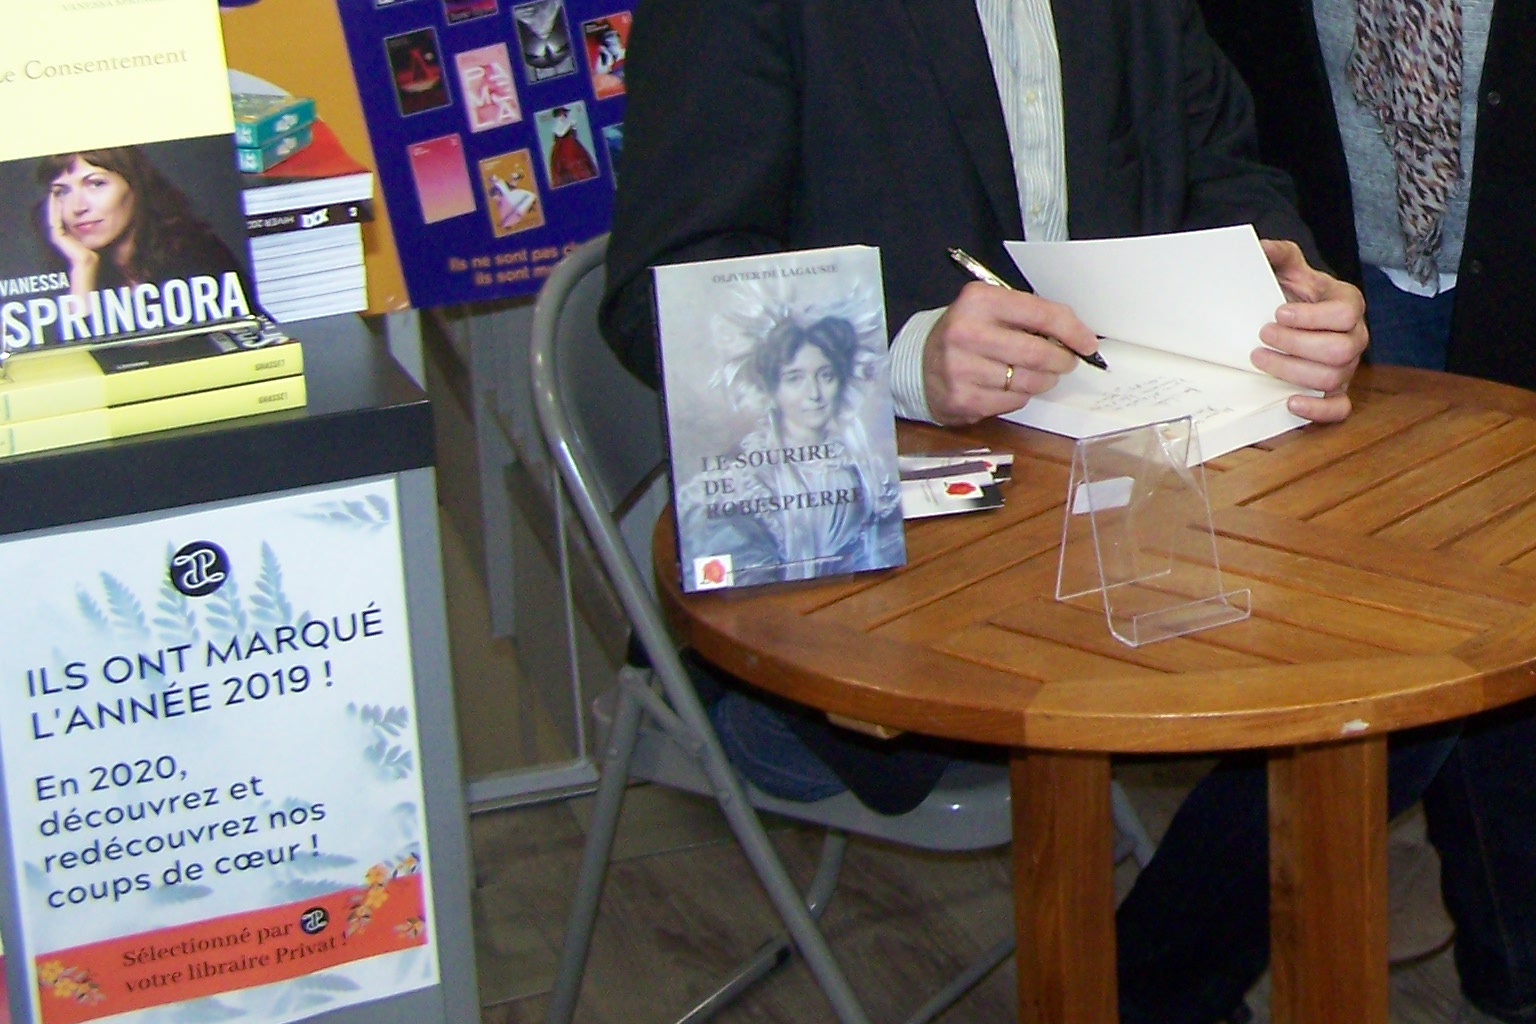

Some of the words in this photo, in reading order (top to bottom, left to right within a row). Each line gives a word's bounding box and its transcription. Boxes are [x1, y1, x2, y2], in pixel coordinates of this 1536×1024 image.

[24, 48, 188, 80] Consentement
[0, 271, 70, 297] VANESSA
[780, 263, 839, 278] LAGAUSIE
[0, 271, 250, 349] SPRINGORA
[702, 455, 729, 472] LE
[735, 442, 838, 469] SOURIRE
[704, 477, 735, 496] DE
[706, 486, 863, 519] ROBESPIERRE
[27, 661, 88, 697] ILS
[103, 642, 192, 684] ONT
[206, 602, 384, 668] MARQUÉ
[32, 681, 212, 740] L'ANNÉE
[223, 664, 311, 707] 2019
[324, 659, 334, 688] !
[36, 774, 79, 802] En
[90, 753, 188, 793] 2020,
[39, 788, 219, 838] découvrez
[230, 774, 265, 801] et
[43, 815, 259, 874] redécouvrez
[269, 801, 327, 832] nos
[48, 871, 151, 909] coups
[163, 857, 204, 888] de
[215, 840, 301, 875] cœur
[310, 833, 319, 858] !
[122, 928, 250, 967] Sélectionné
[257, 921, 293, 947] par
[126, 969, 182, 994] votre
[188, 952, 270, 980] libraire
[276, 939, 337, 964] Privat
